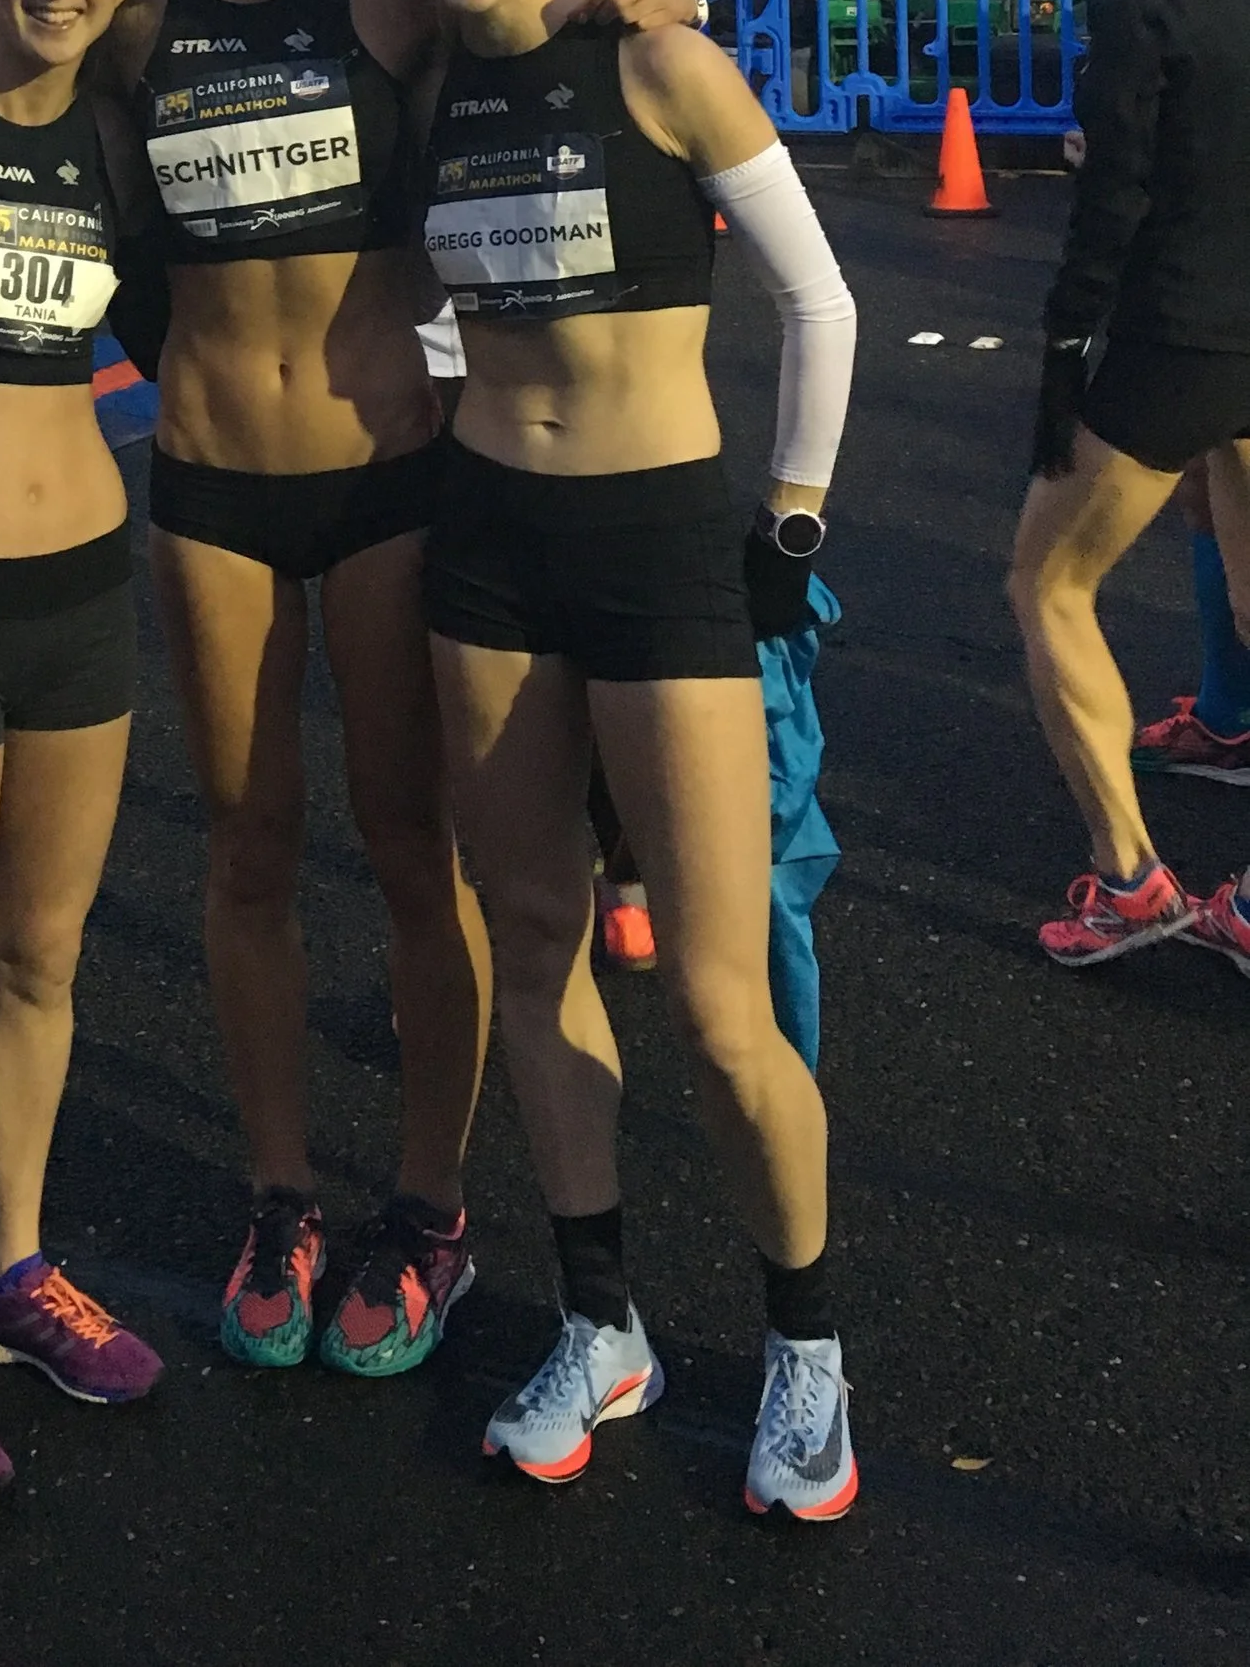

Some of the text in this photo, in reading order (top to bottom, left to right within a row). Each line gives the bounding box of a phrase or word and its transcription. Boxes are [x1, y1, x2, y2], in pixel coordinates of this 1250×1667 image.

[170, 38, 247, 54] STRAVA
[196, 73, 284, 97] CALIFORNIA
[199, 96, 288, 120] MARATHON
[450, 98, 509, 118] STRAVA
[156, 136, 351, 185] SCHNITTGER
[470, 147, 541, 167] CALIFORNIA
[468, 173, 542, 190] MARATHON
[19, 236, 108, 260] MARATHON
[427, 222, 603, 252] GREGG GOODMAN
[0, 252, 75, 307] 304
[14, 304, 57, 322] TANIA
